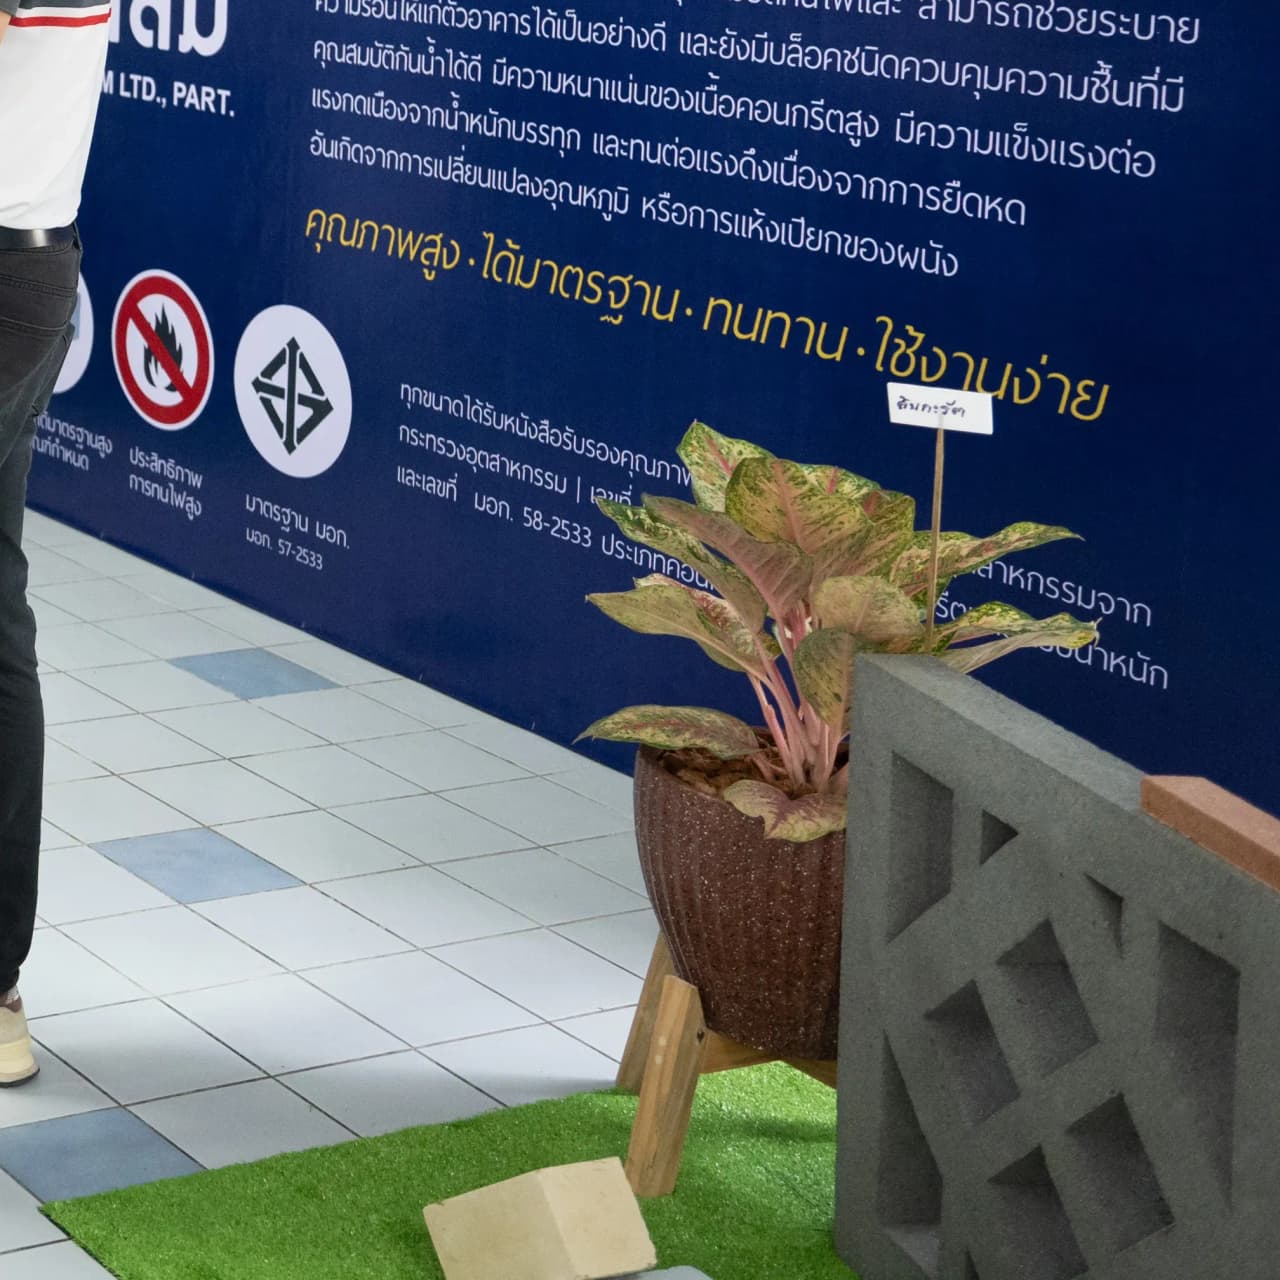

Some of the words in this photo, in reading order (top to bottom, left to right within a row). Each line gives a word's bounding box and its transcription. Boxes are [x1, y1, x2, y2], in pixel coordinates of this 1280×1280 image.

[119, 72, 167, 109] LTD.,
[173, 81, 235, 117] PART.
[314, 37, 481, 81] คุณสมบัติกันน้ำได้ดี
[493, 58, 879, 147] มีความหนาแน่นของเนื้อคอนกรีตสูง
[896, 111, 1155, 177] มีความแข็งแรงต่อ
[311, 130, 628, 221] อันเกิดจากการเปลี่ยนแปลงอุณหภูมิ
[643, 192, 958, 276] หรือการแห้งเปียกของผนัง
[594, 133, 1025, 225] และทนต่อแรงดึงเนื่องจากการยืดหด
[306, 209, 460, 279] คุณภาพสูง
[483, 232, 679, 324] ได้มาตรฐาน
[703, 296, 848, 361] ทนทาน
[876, 316, 1108, 420] ใช้งานง่าย
[400, 425, 566, 493] กระทรวงอุตสาหกรรม
[130, 475, 201, 518] การทนไฟสูง
[247, 495, 308, 532] มาตรฐาน
[316, 522, 349, 548] มอก.
[398, 467, 457, 501] และเลขที่
[475, 493, 512, 520] มอก.
[524, 507, 591, 547] 58-2533
[246, 528, 272, 550] มอก.
[279, 539, 322, 569] 57-2533
